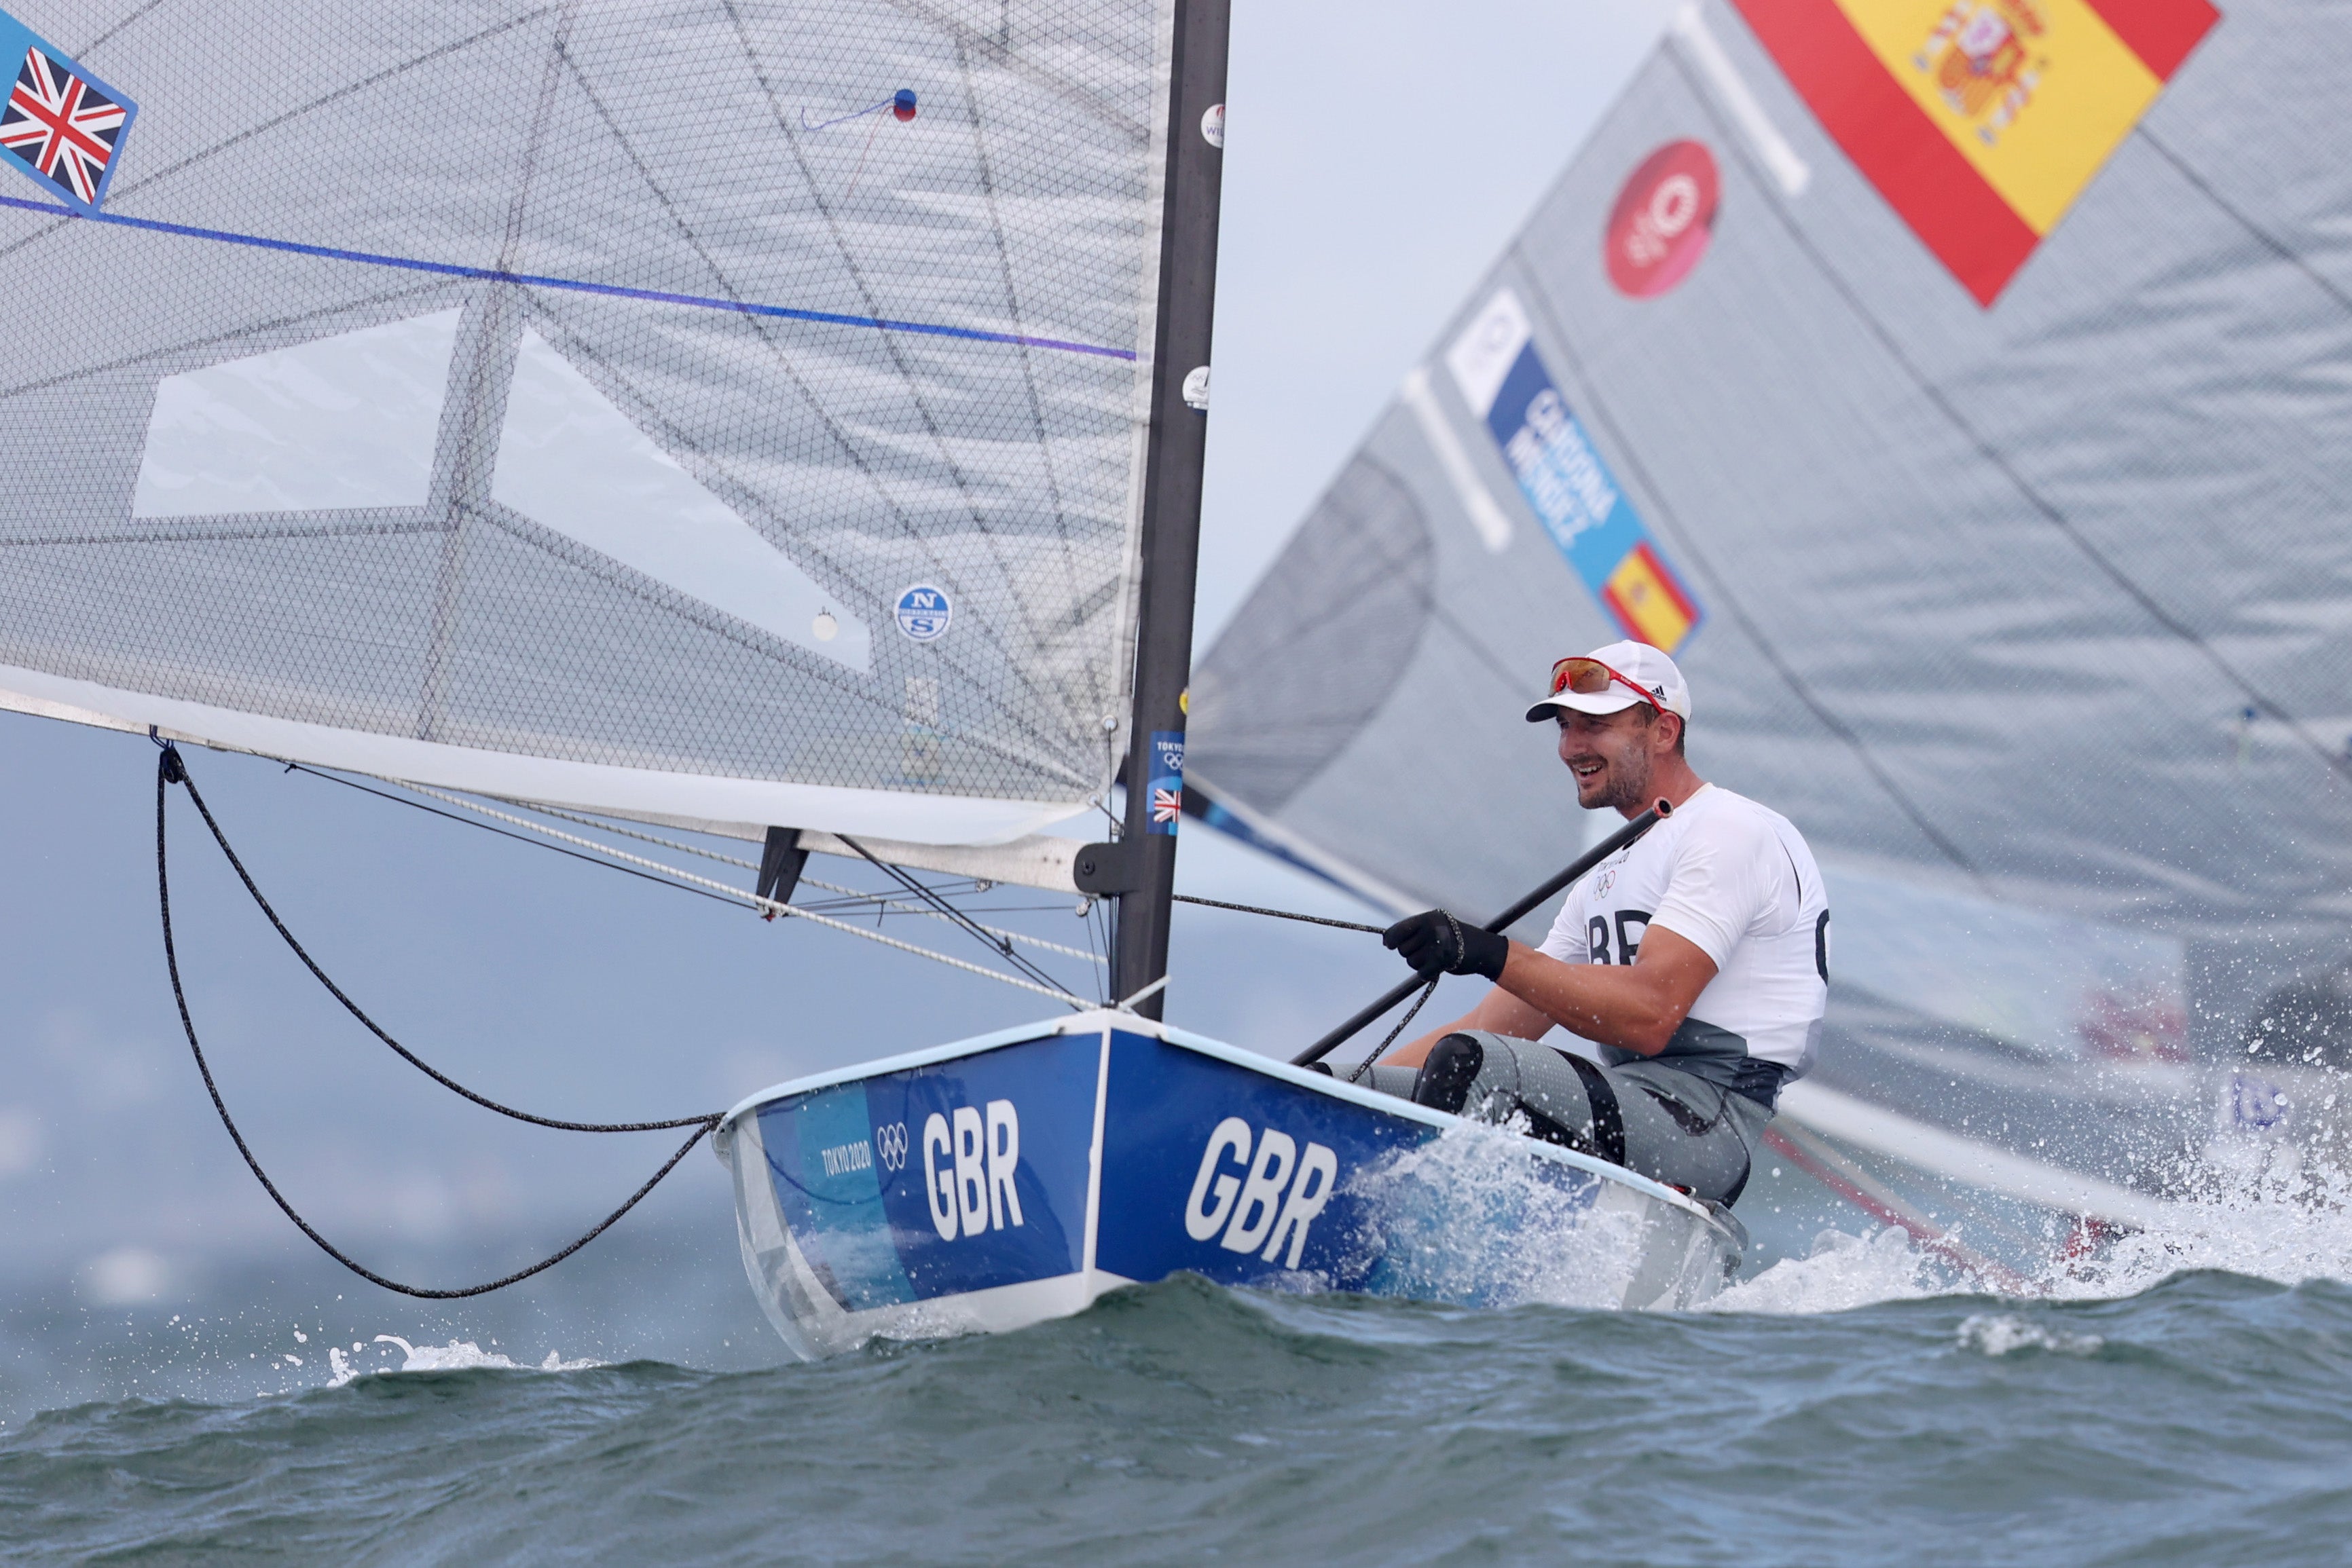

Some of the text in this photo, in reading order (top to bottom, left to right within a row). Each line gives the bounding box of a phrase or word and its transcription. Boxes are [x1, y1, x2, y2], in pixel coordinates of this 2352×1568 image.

[1157, 741, 1183, 752] TOKYO
[1584, 910, 1653, 966] BR
[822, 1140, 871, 1178] TOKYO 2020
[923, 1099, 1024, 1242] GBR
[1185, 1117, 1338, 1271] GBR
